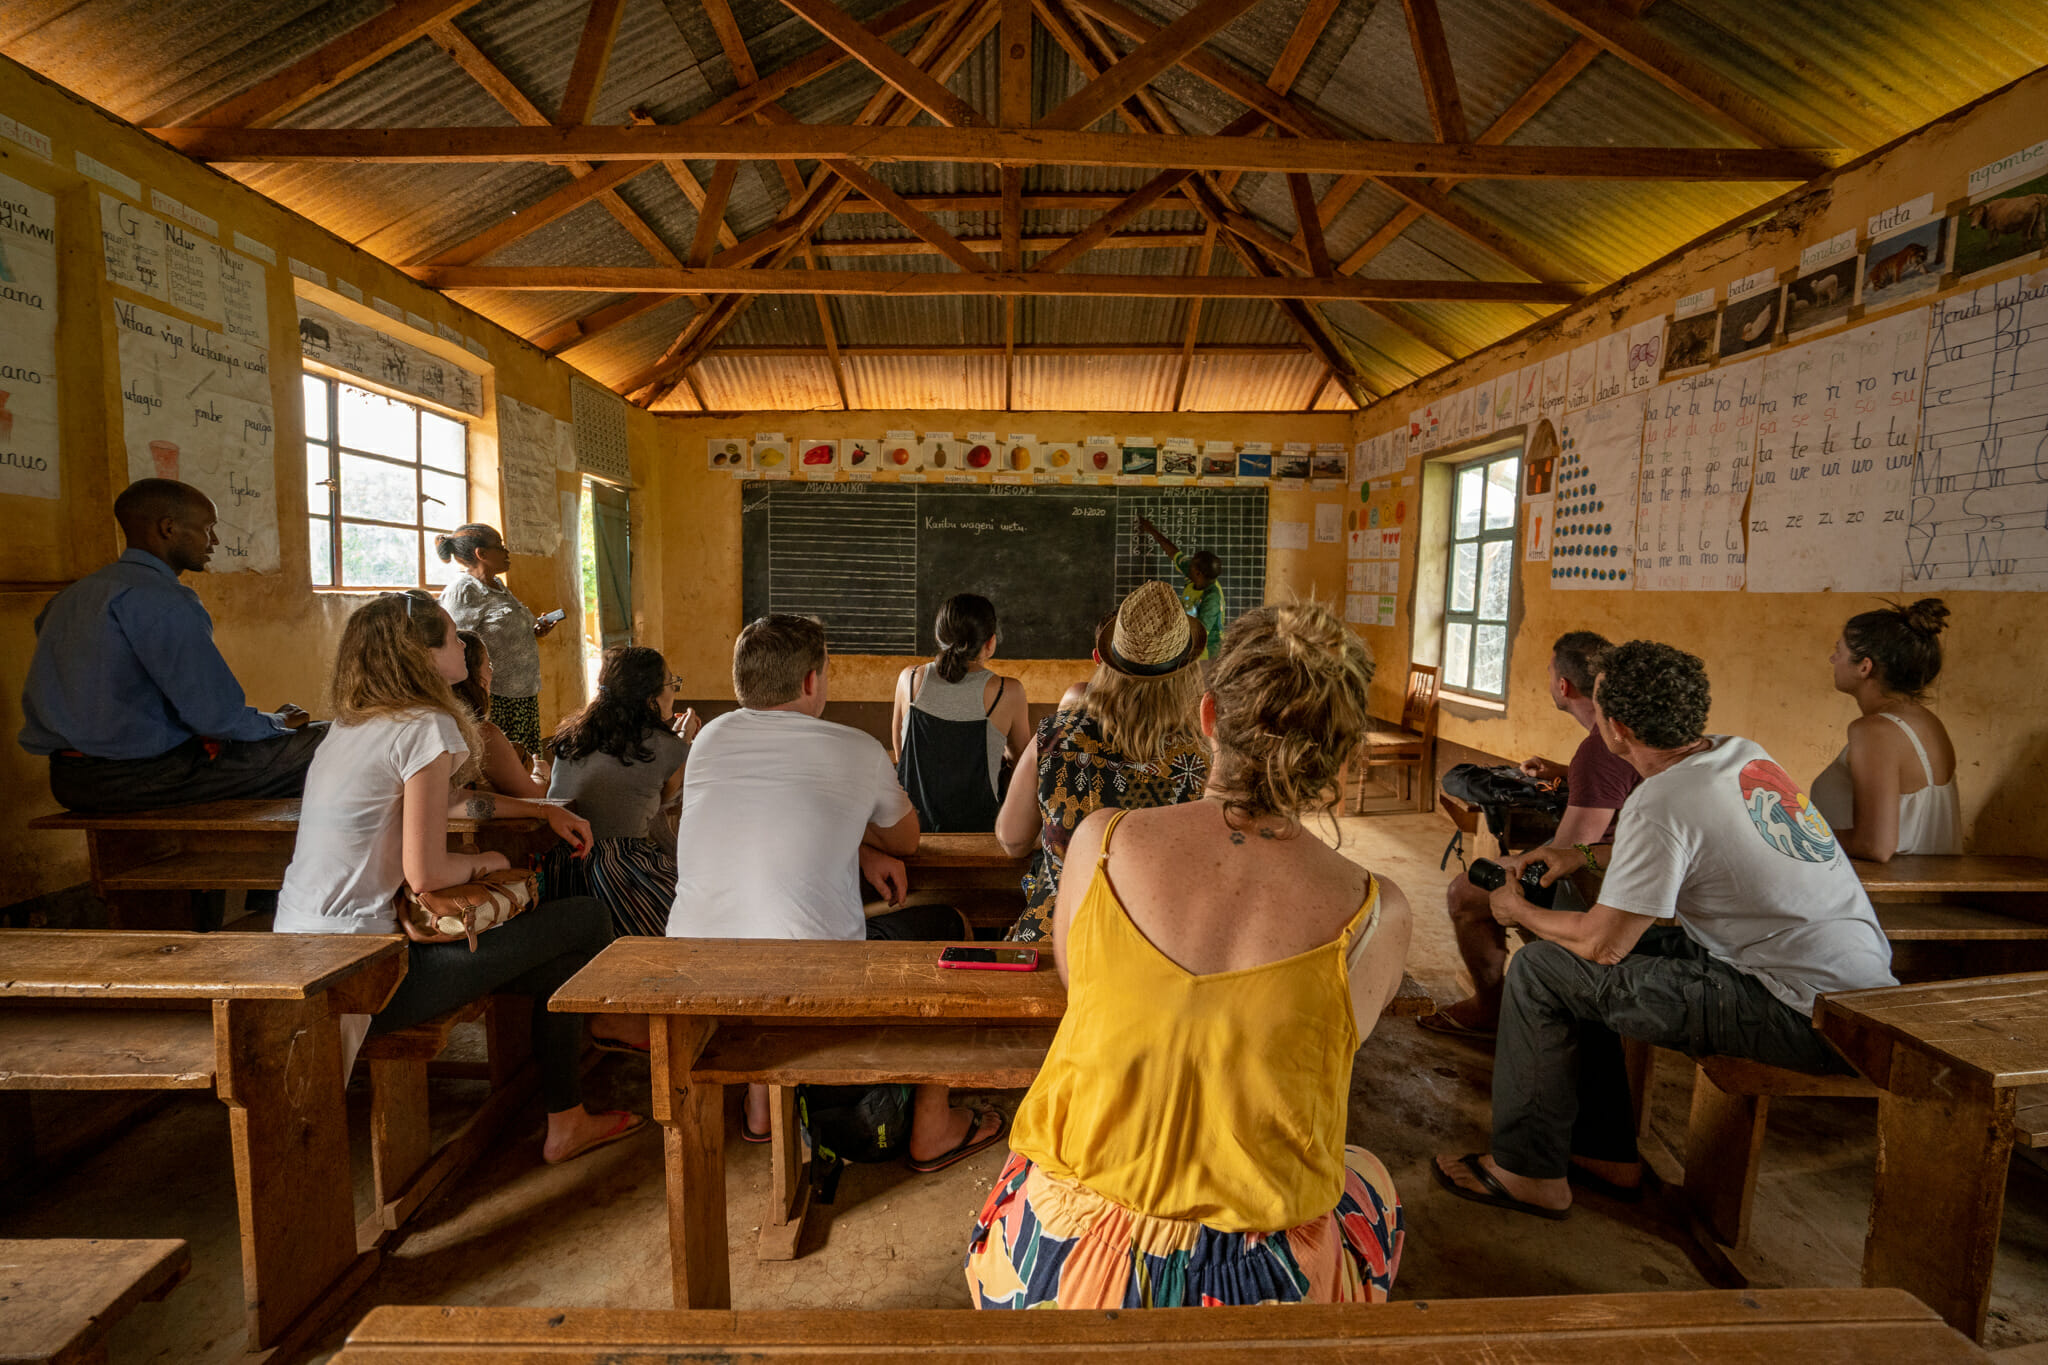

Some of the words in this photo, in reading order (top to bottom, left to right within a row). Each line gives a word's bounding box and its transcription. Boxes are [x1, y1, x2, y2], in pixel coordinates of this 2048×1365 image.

[1870, 205, 1911, 235] chita
[1729, 277, 1754, 297] bata
[160, 330, 184, 359] vya
[1596, 375, 1620, 402] dada
[1631, 368, 1650, 389] tai
[1761, 400, 1777, 415] ra
[1792, 393, 1808, 408] re
[1856, 377, 1877, 394] ro
[1892, 368, 1918, 386] ru
[1646, 398, 1658, 421] ba
[1666, 390, 1680, 419] be
[1713, 379, 1730, 412] bo
[1739, 377, 1757, 407] bu
[1760, 422, 1777, 435] sa
[1792, 414, 1810, 428] se
[1856, 400, 1876, 415] so
[1889, 389, 1917, 406] su
[193, 400, 224, 428] jembe
[1710, 411, 1726, 434] do
[1736, 406, 1754, 427] du
[244, 419, 273, 446] panga
[1758, 439, 1773, 462] ta
[1791, 431, 1808, 459] te
[1850, 421, 1872, 449] to
[1887, 416, 1909, 447] tu
[1704, 474, 1720, 496] ho
[1732, 471, 1748, 493] hu
[1705, 461, 1721, 488] go
[1732, 456, 1750, 485] gu
[1755, 471, 1776, 485] wa
[1790, 466, 1810, 480] we
[1851, 459, 1873, 474] wo
[1912, 448, 1956, 496] Mm
[925, 516, 956, 530] Karibu
[960, 519, 994, 535] wageni
[1752, 521, 1769, 532] za
[1785, 515, 1804, 528] ze
[1818, 512, 1833, 525] zi
[1845, 511, 1865, 524] zo
[1882, 510, 1905, 523] zu
[1908, 496, 1942, 539] Rr
[1963, 488, 2005, 532] Ss
[226, 537, 249, 557] reki
[1639, 532, 1648, 552] la
[1658, 531, 1666, 552] le
[1699, 530, 1710, 550] lo
[1726, 529, 1738, 550] lu
[1636, 558, 1652, 568] ma
[1659, 556, 1672, 568] me
[1679, 554, 1692, 566] mi
[1700, 553, 1719, 564] mo
[1728, 553, 1745, 564] mu
